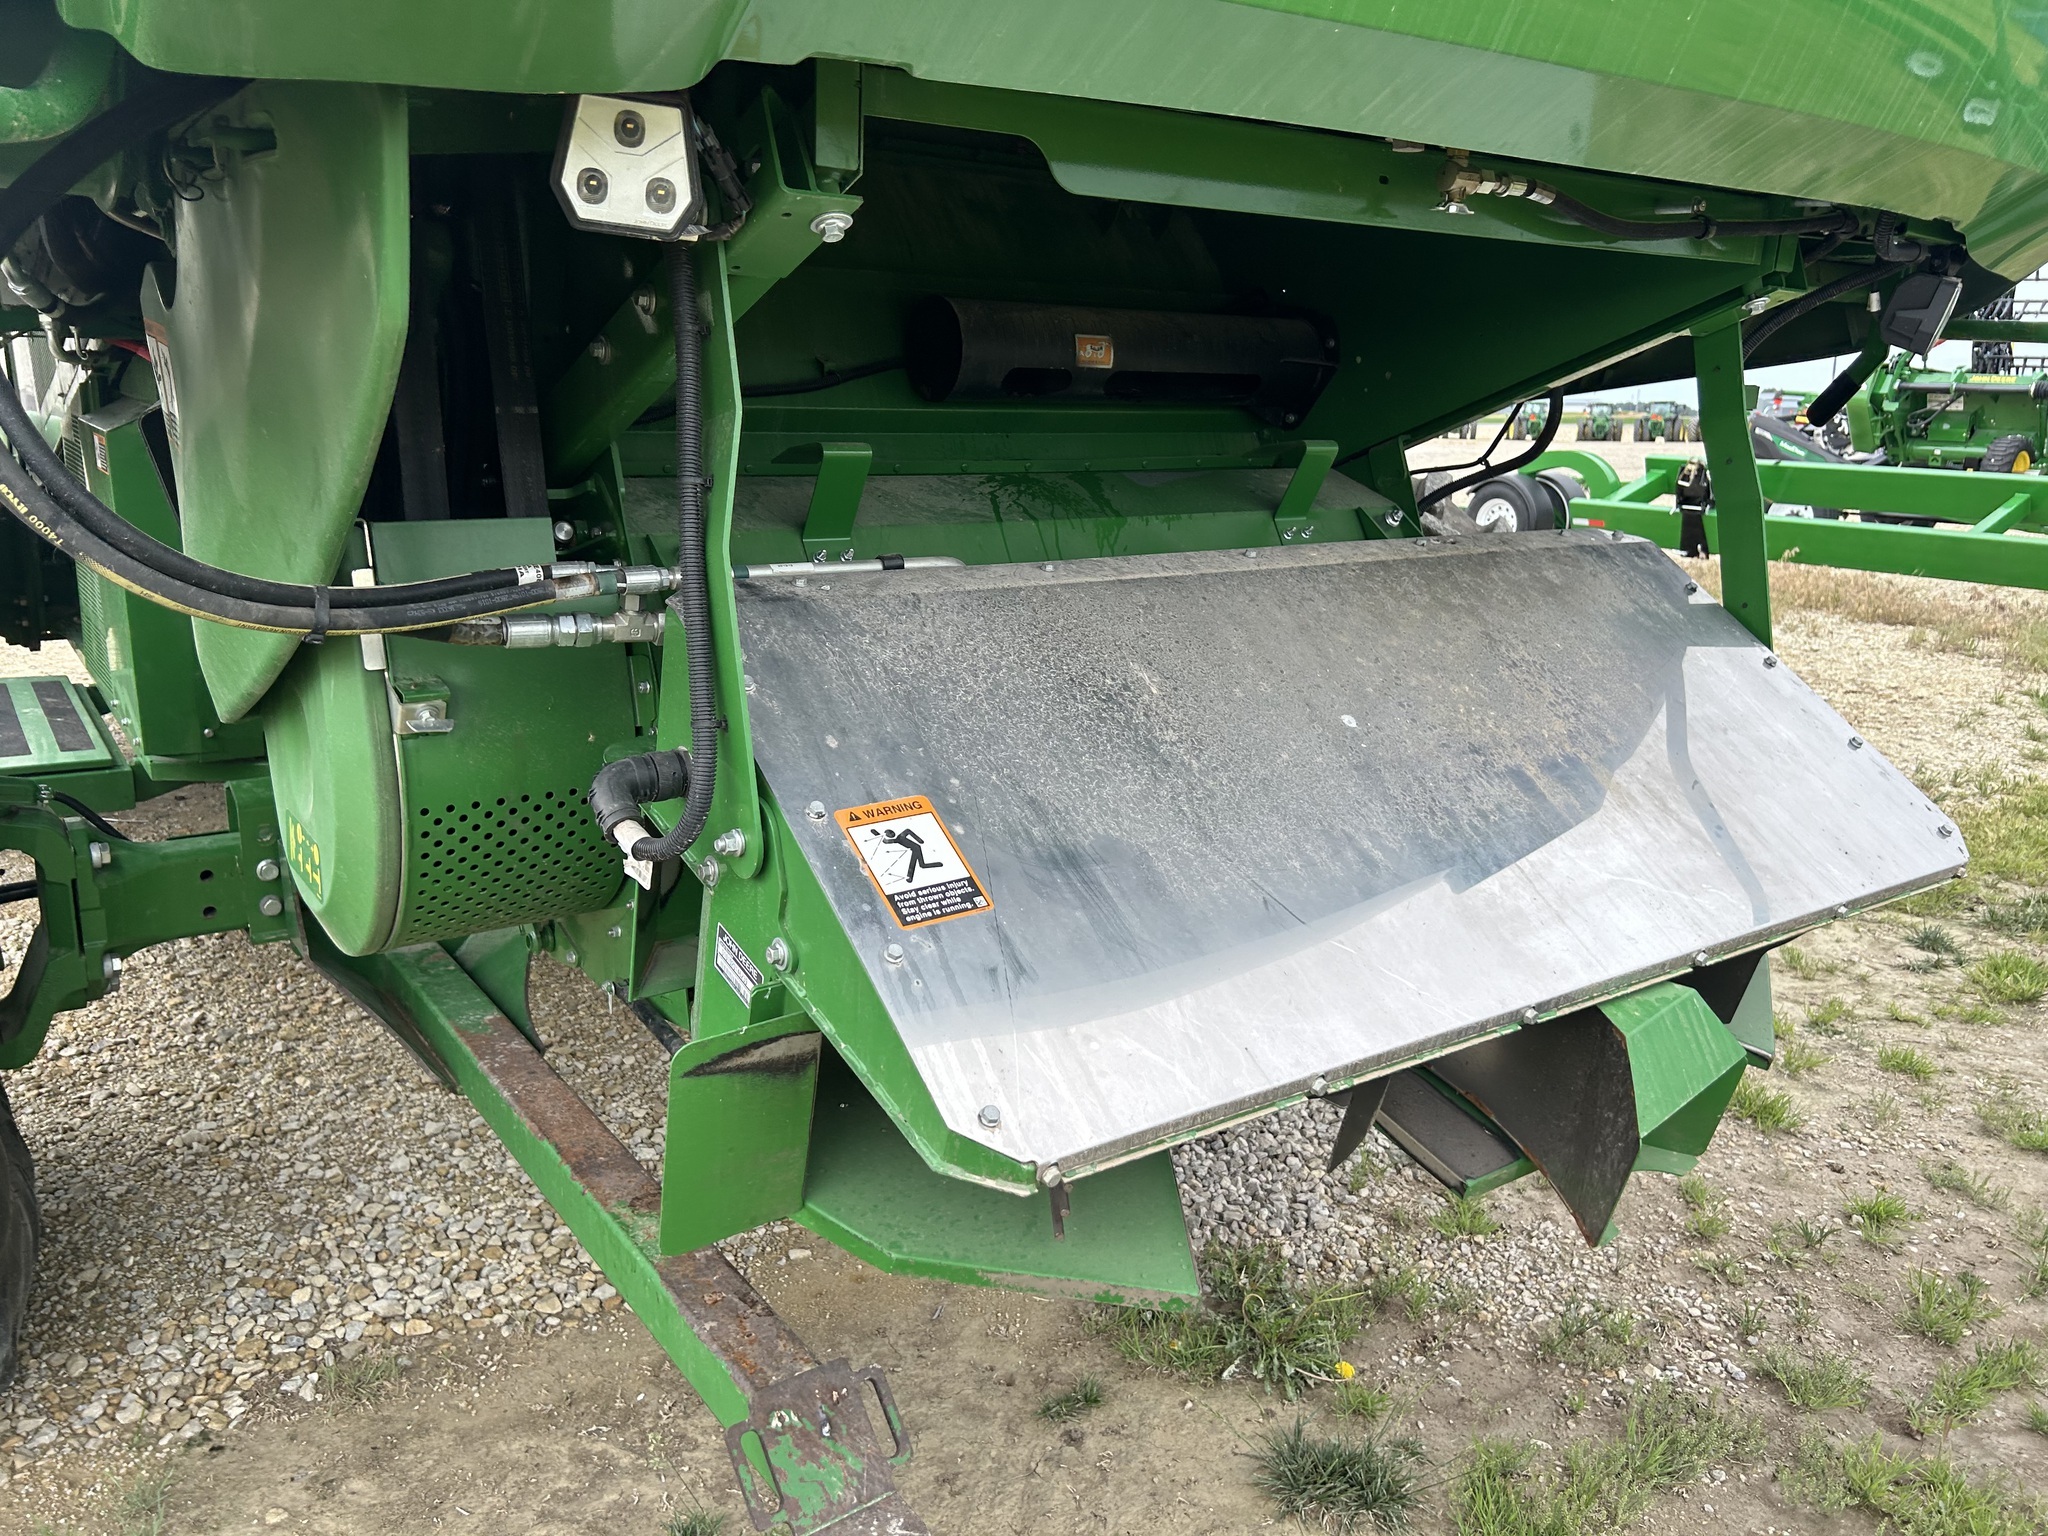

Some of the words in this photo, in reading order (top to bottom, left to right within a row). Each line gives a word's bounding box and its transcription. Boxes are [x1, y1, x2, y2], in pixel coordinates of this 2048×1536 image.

[1969, 374, 1990, 383] JOHN
[1989, 375, 2017, 384] DEERE
[28, 514, 64, 546] T4000
[862, 801, 923, 819] WARNING
[894, 890, 917, 902] Avoid
[917, 885, 946, 897] serious
[947, 879, 969, 891] injury
[897, 899, 917, 909] from
[917, 893, 944, 904] thrown
[945, 887, 975, 899] objects.
[901, 905, 920, 916] Stay
[921, 900, 940, 910] clear
[941, 896, 962, 906] while
[906, 911, 932, 922] engine
[933, 908, 941, 917] is
[942, 902, 974, 915] running.
[722, 933, 739, 955] JOHN
[738, 951, 759, 980] DEERE
